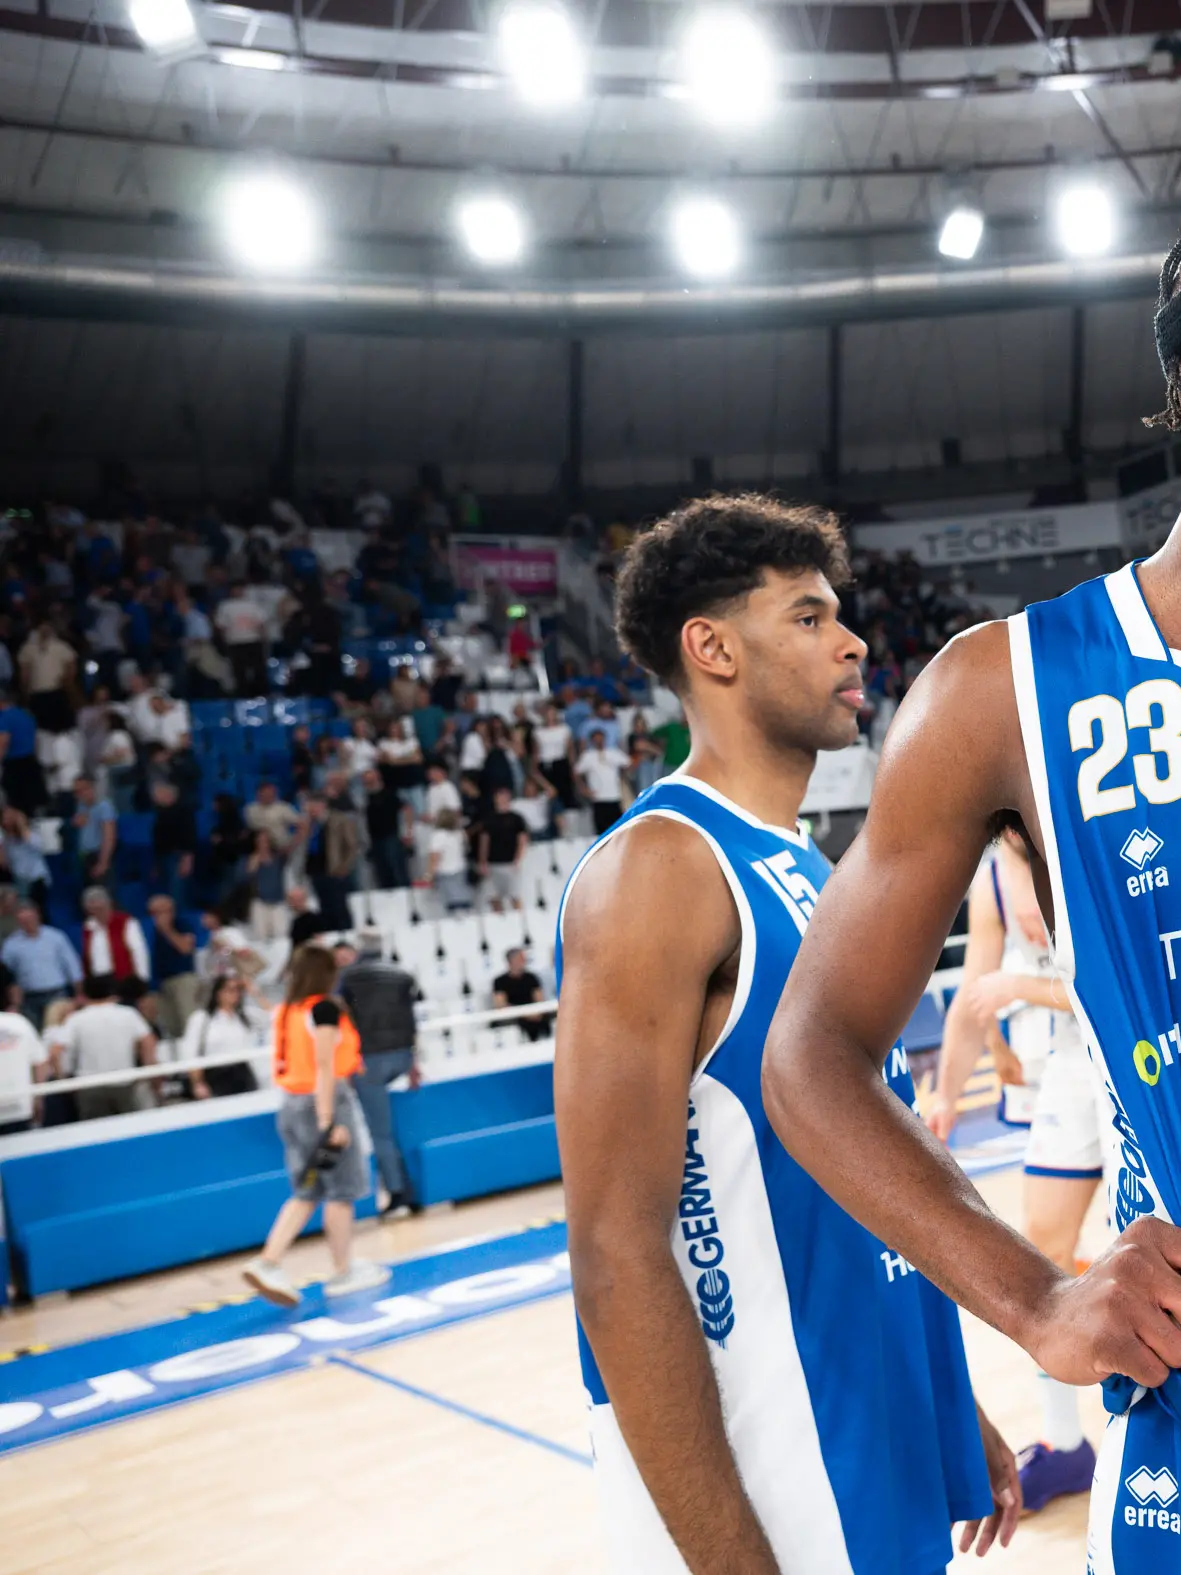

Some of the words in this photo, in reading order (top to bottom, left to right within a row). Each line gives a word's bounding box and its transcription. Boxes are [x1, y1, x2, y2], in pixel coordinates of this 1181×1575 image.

[921, 521, 1061, 555] TECHNE
[678, 1098, 725, 1269] GERMA
[1123, 1504, 1181, 1535] errea
